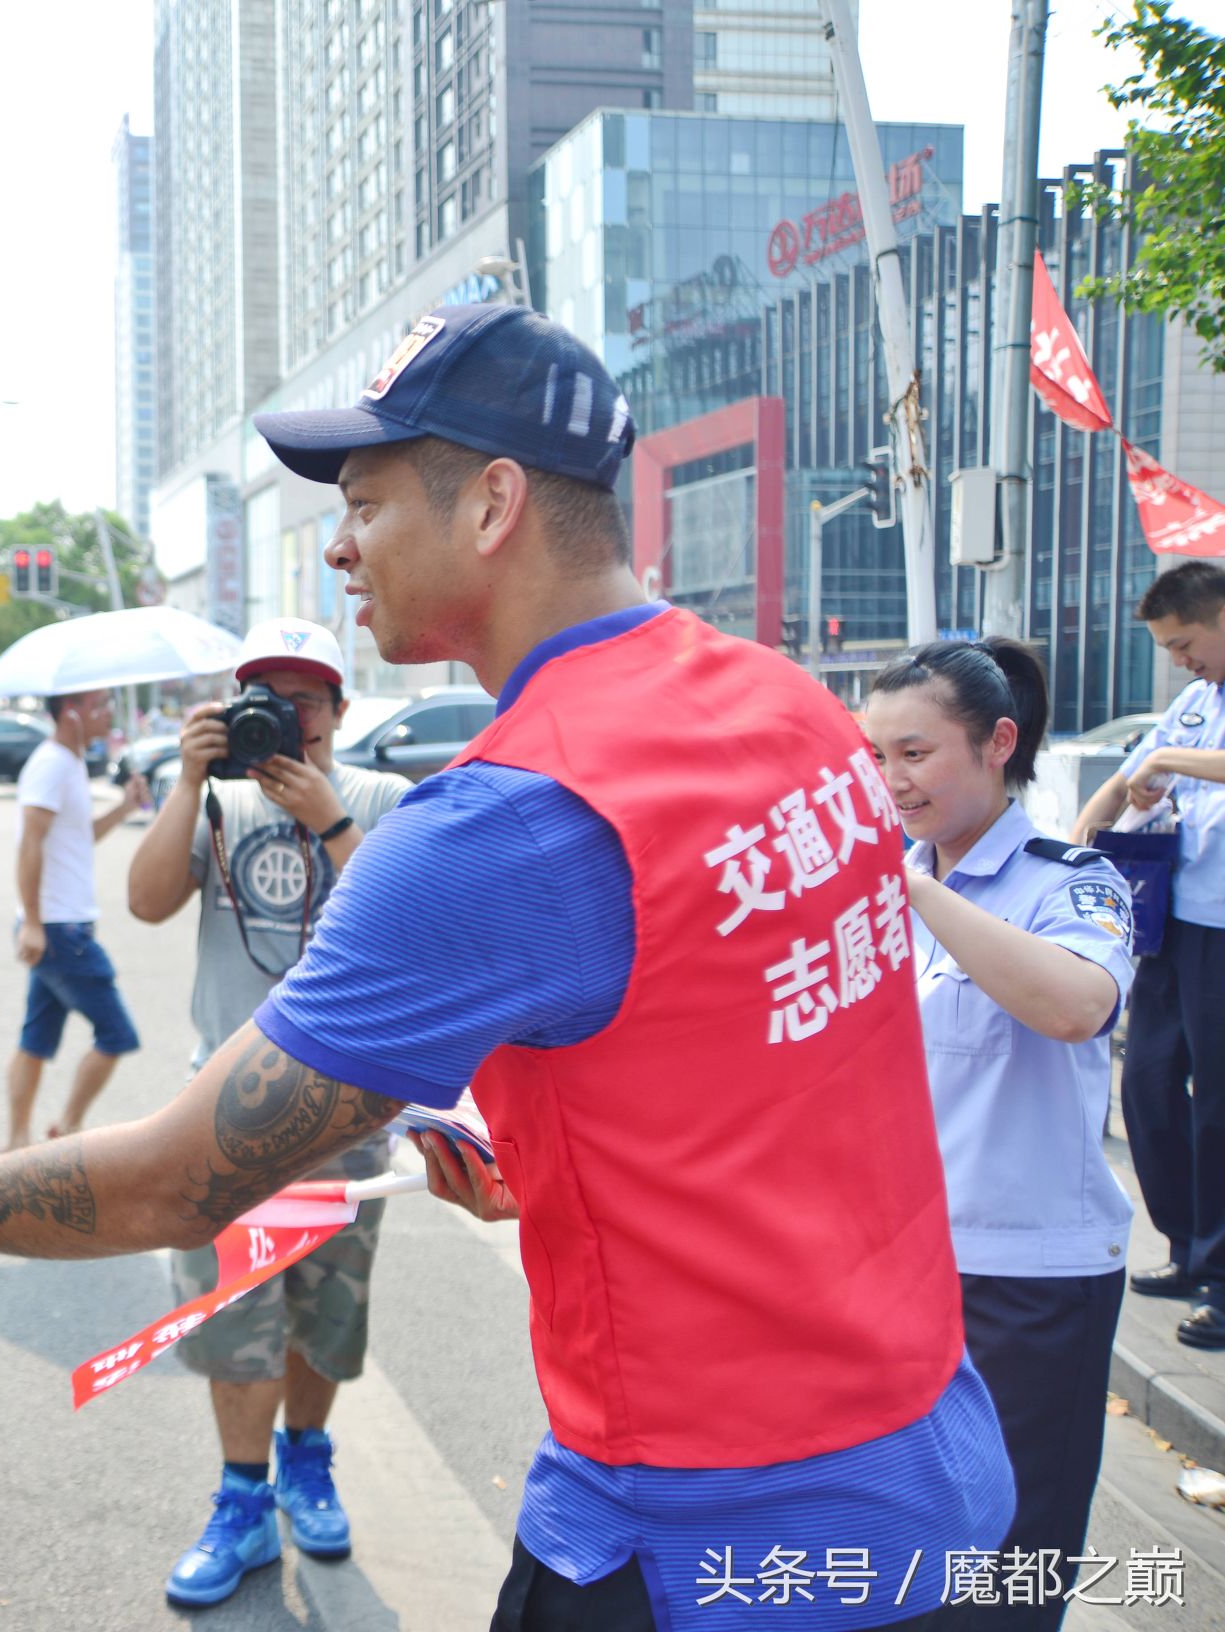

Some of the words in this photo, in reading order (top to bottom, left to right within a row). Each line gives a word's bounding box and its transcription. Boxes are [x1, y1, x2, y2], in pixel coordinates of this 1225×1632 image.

[703, 747, 901, 937] 交通文明
[764, 874, 911, 1044] 志愿者
